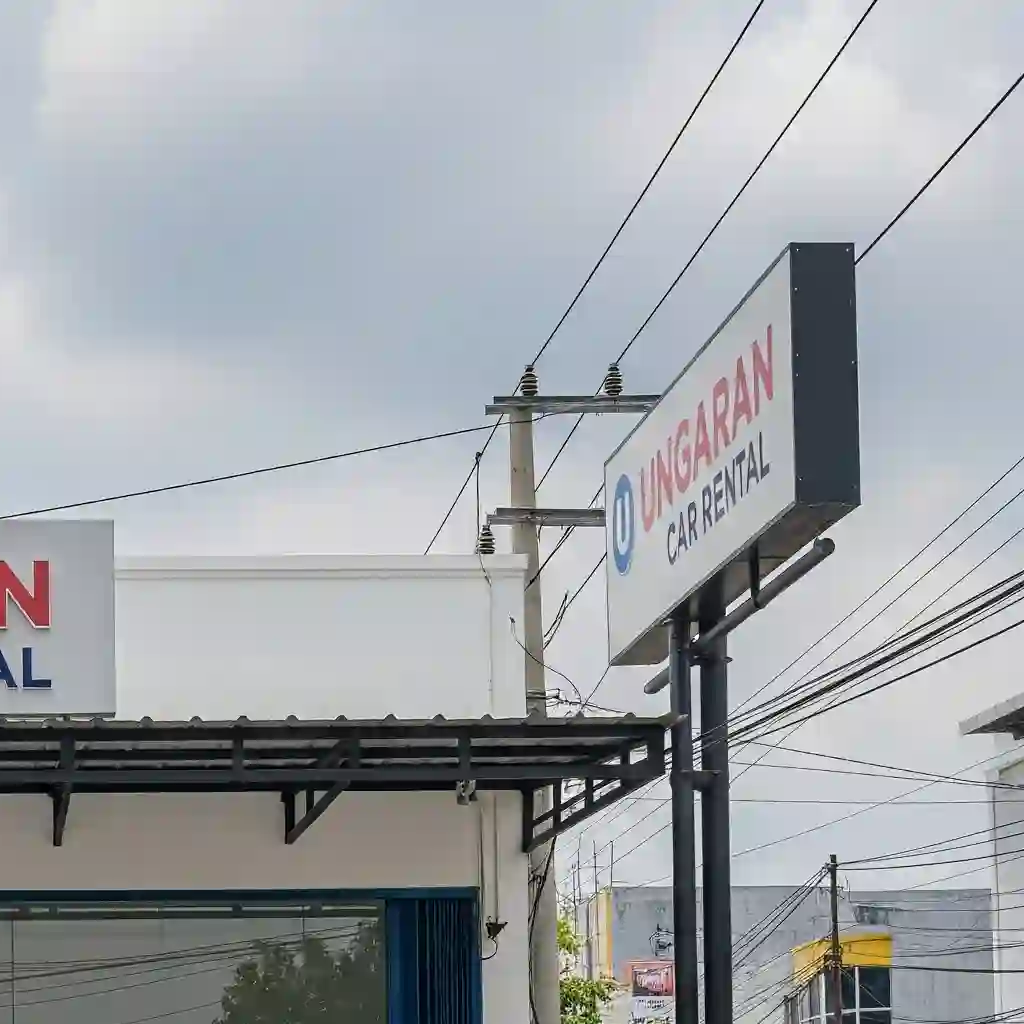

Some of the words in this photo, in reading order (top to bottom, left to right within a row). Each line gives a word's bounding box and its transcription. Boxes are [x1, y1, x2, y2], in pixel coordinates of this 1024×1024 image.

[638, 323, 774, 533] UNGARAN
[666, 501, 697, 565] CAR
[702, 431, 770, 534] RENTAL
